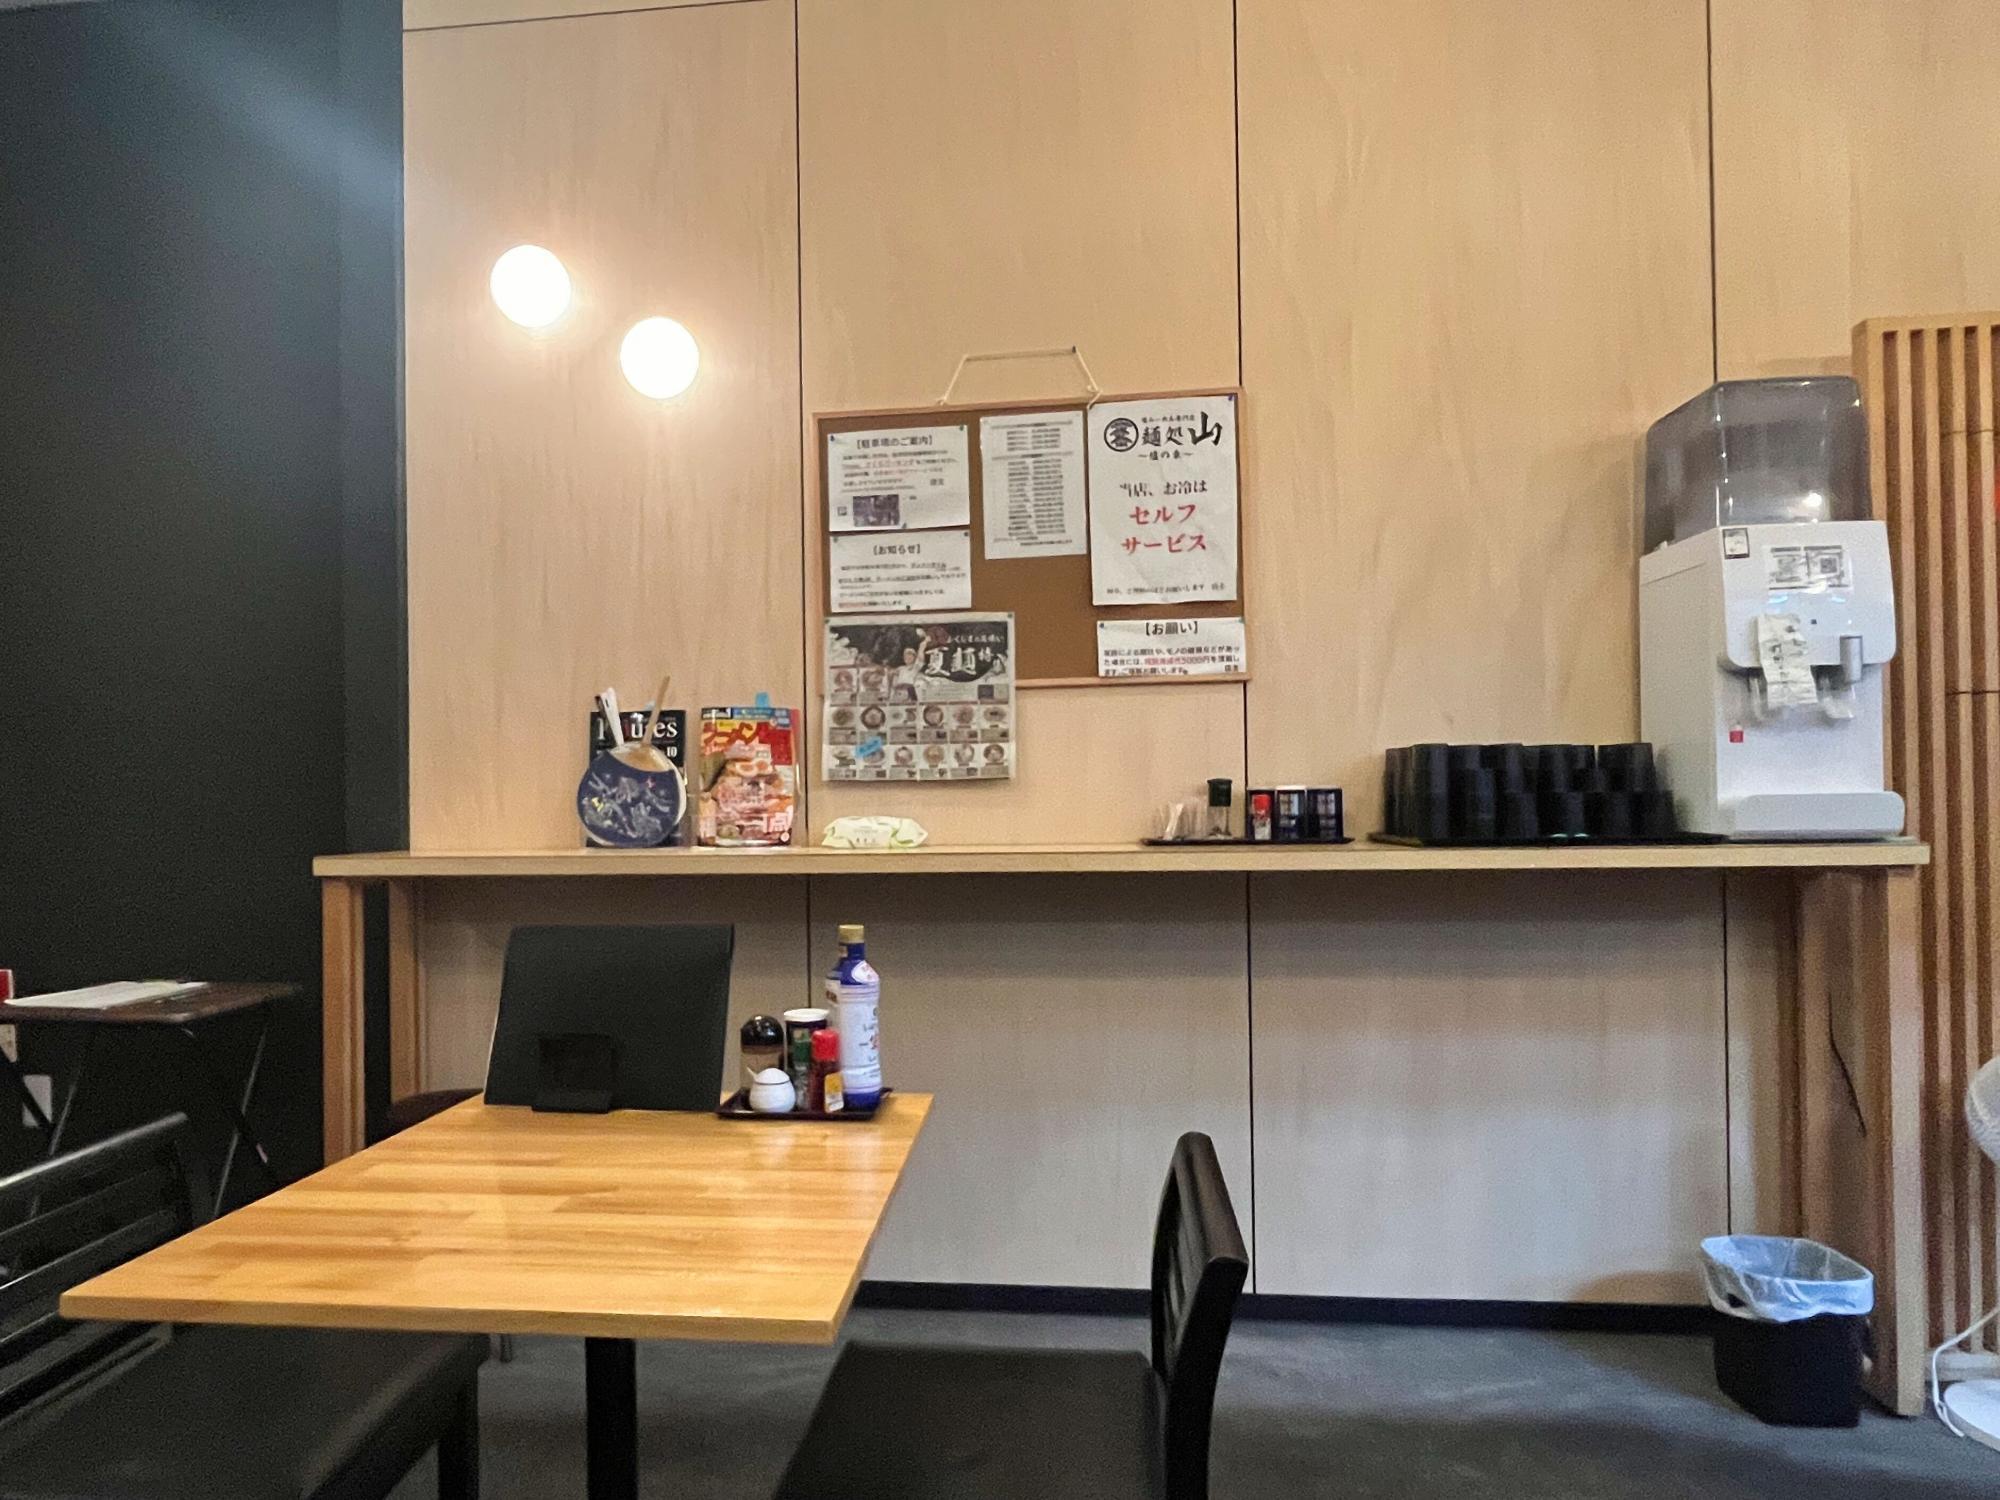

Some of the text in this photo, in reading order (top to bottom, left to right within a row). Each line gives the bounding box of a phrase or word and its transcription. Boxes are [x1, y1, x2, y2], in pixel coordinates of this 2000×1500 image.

[1128, 504, 1197, 526] セルフ
[1120, 533, 1207, 556] サービス
[1145, 620, 1199, 637] 【お願い】
